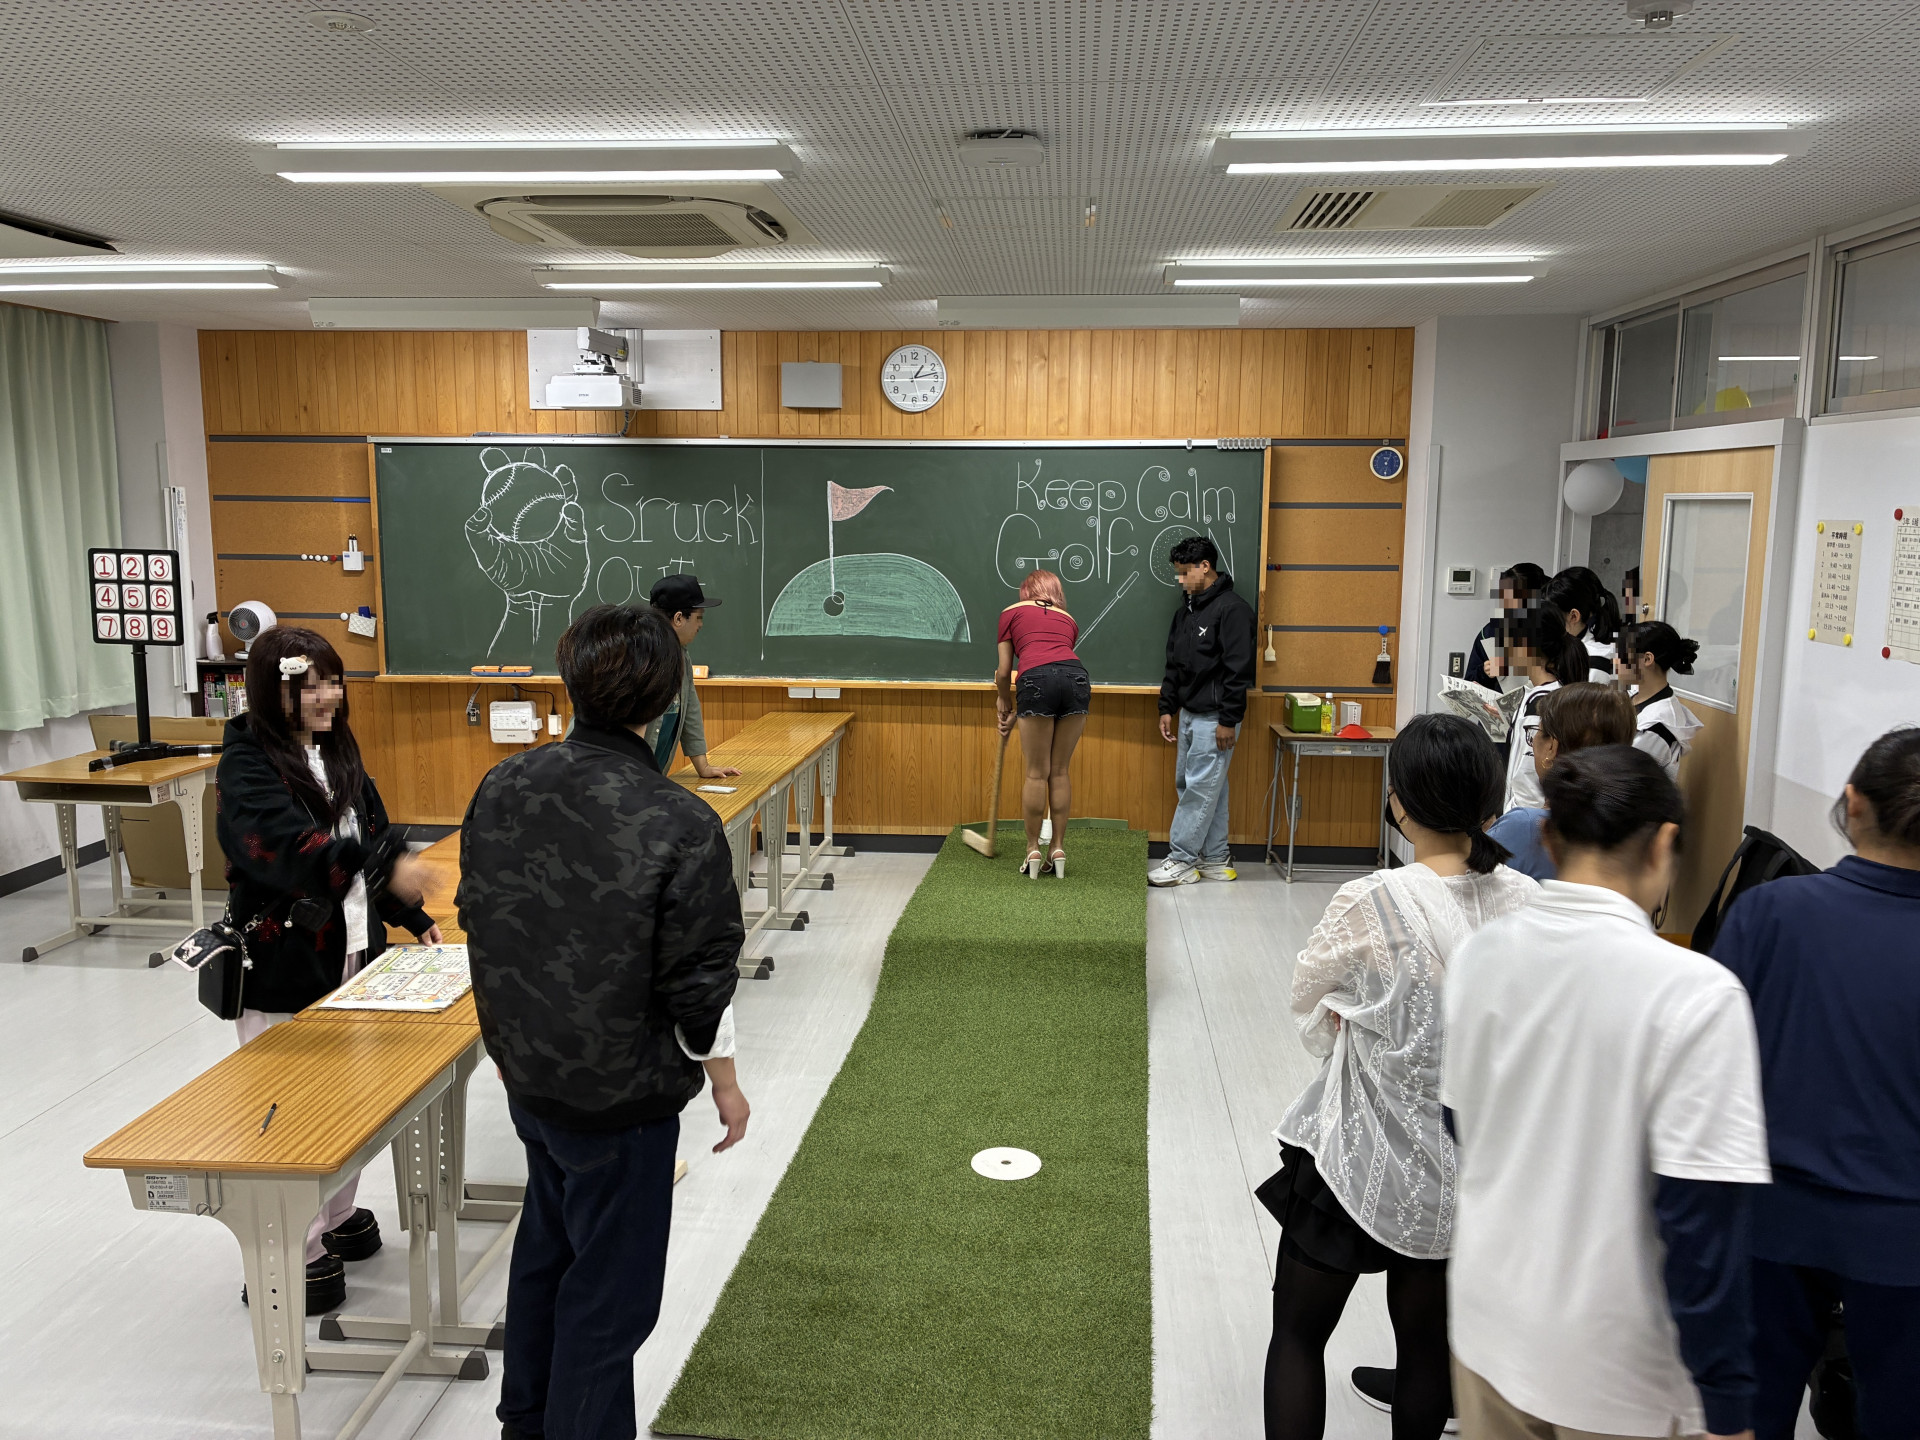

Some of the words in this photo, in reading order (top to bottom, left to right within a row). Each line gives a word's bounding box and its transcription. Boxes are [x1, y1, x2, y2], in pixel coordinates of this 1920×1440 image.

[900, 355, 907, 363] 11
[911, 352, 919, 360] 12
[892, 364, 900, 372] 10
[930, 363, 936, 371] 2
[893, 386, 899, 394] 8
[930, 386, 935, 394] 4
[902, 394, 907, 402] 7
[923, 394, 928, 402] 5
[1015, 458, 1127, 536] Keep
[1137, 465, 1236, 524] Calm
[995, 513, 1139, 590] Golf
